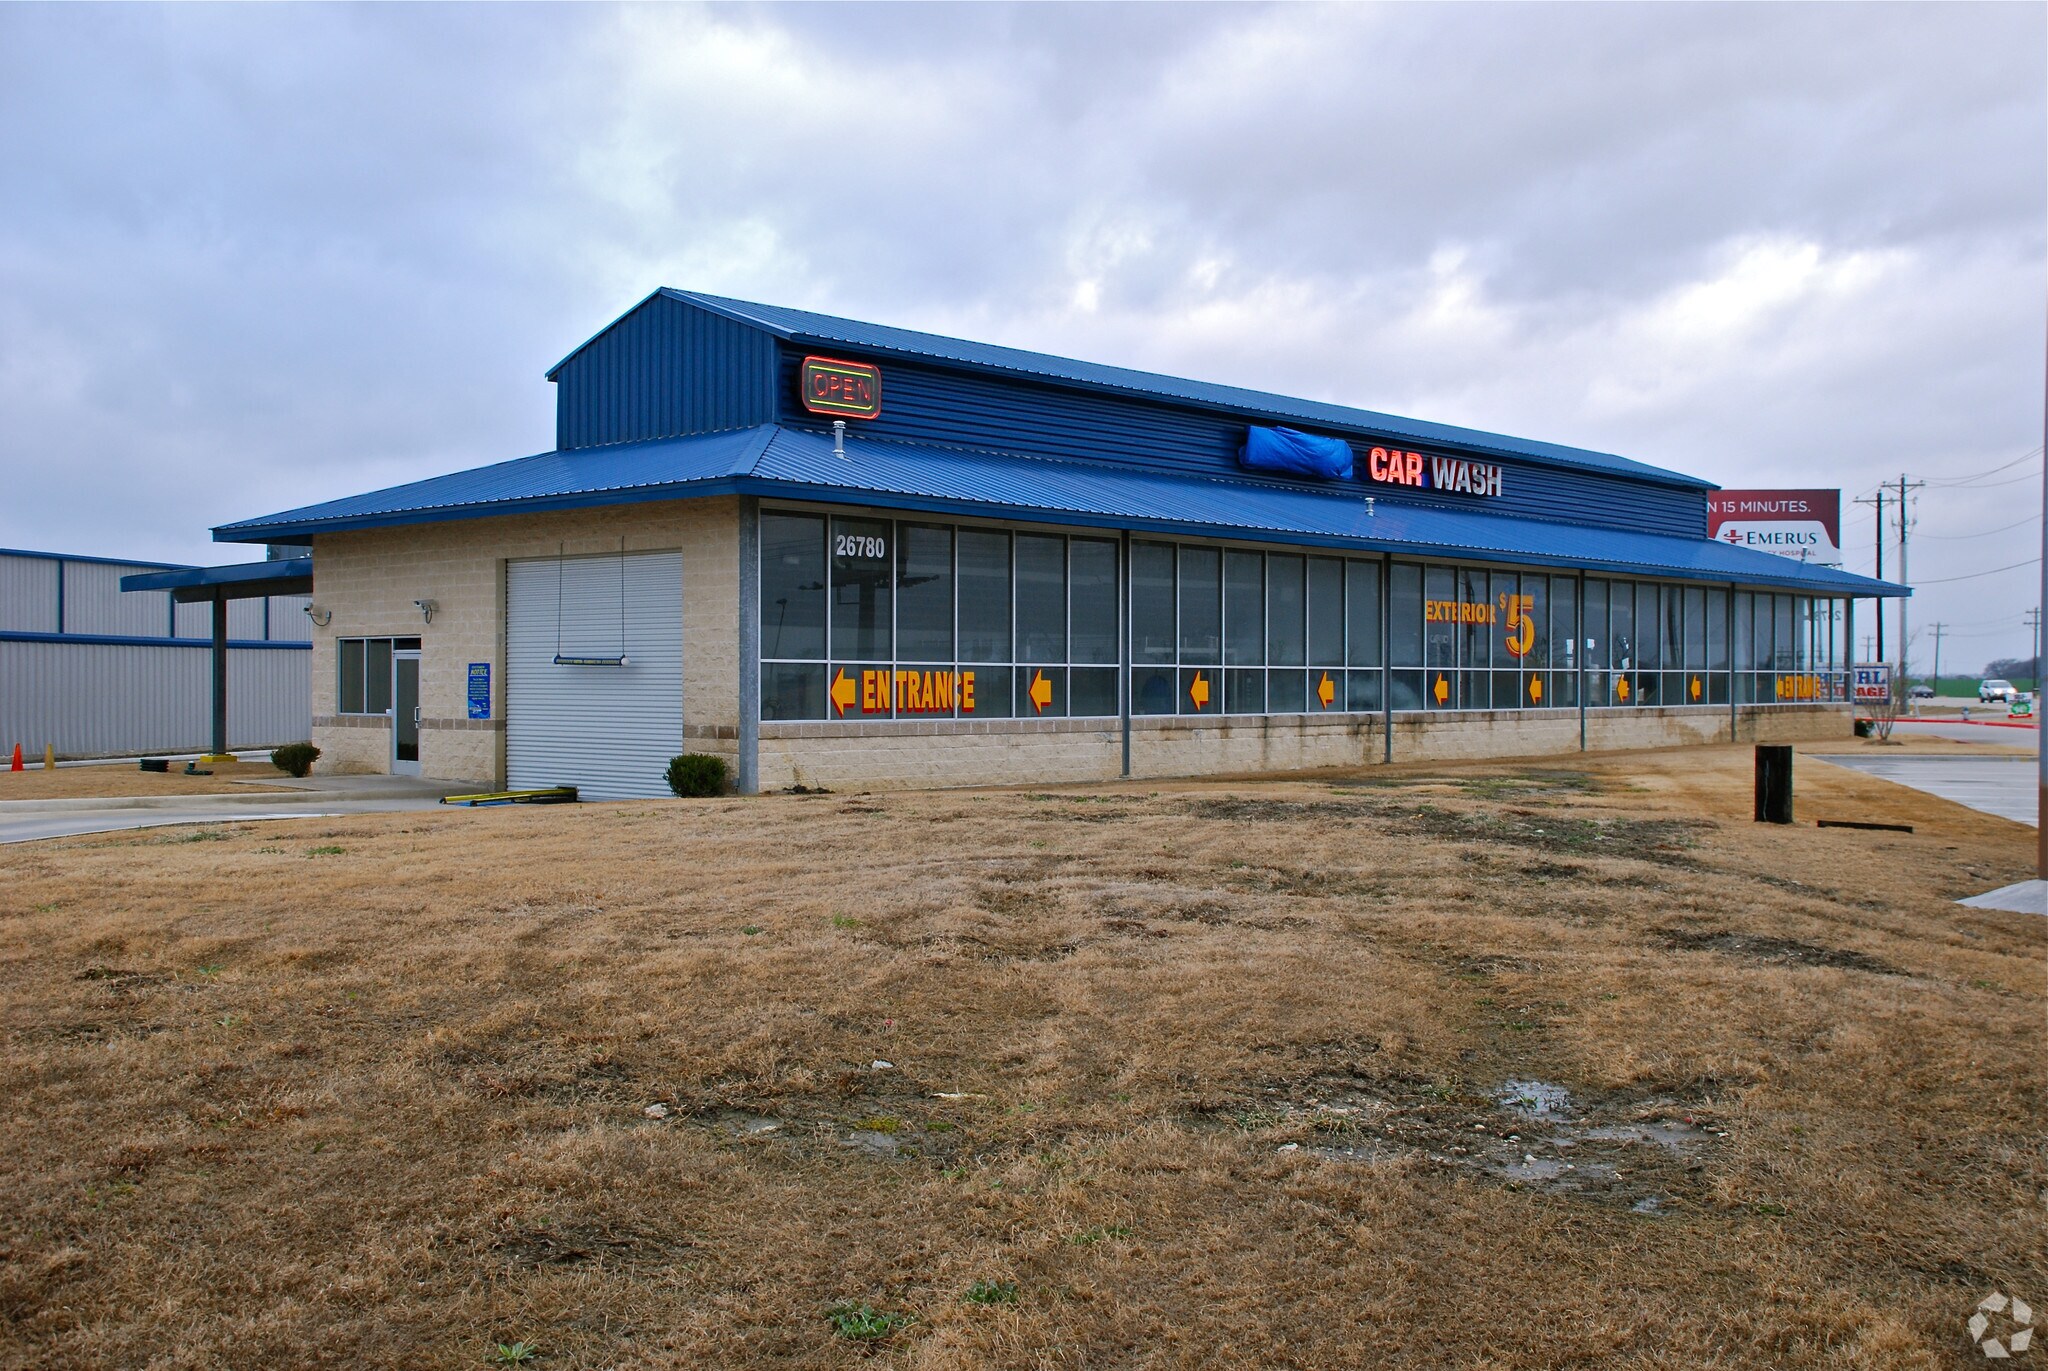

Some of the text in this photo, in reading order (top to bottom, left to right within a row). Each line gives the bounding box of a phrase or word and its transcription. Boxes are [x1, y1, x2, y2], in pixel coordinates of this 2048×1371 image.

[814, 374, 871, 401] OPEN
[1369, 446, 1502, 497] CAR WASH
[1721, 501, 1736, 513] 15
[1740, 500, 1811, 513] MINUTES.
[836, 534, 885, 559] 26780
[1746, 531, 1817, 545] EMERUS
[1425, 600, 1497, 625] EXTERIOR
[861, 669, 976, 714] ENTRANCE
